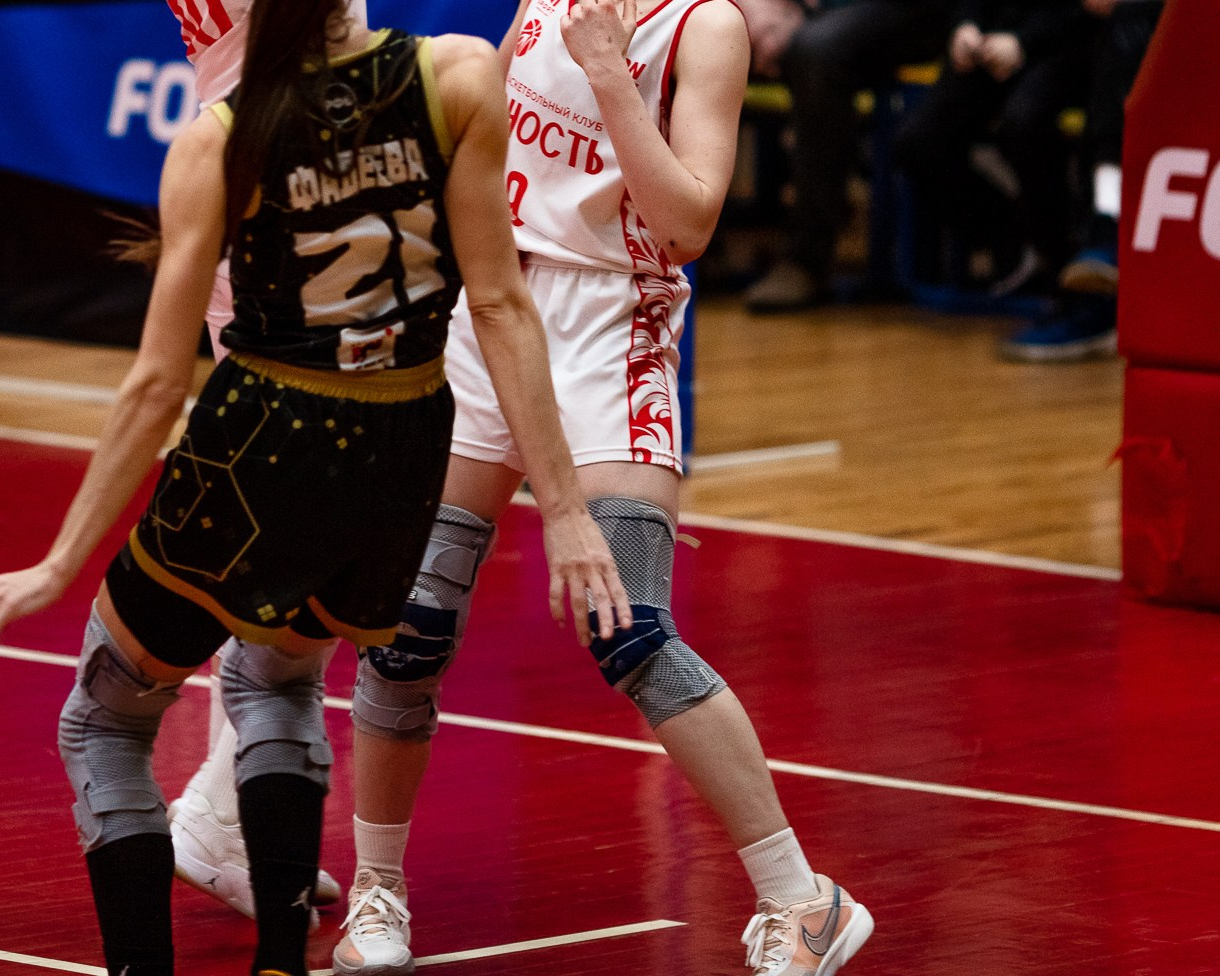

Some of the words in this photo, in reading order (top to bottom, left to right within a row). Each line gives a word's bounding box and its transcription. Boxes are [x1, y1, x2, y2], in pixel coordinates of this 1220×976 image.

[509, 98, 605, 176] НОСТЬ
[572, 111, 604, 133] КЛУБ
[293, 198, 447, 328] 21
